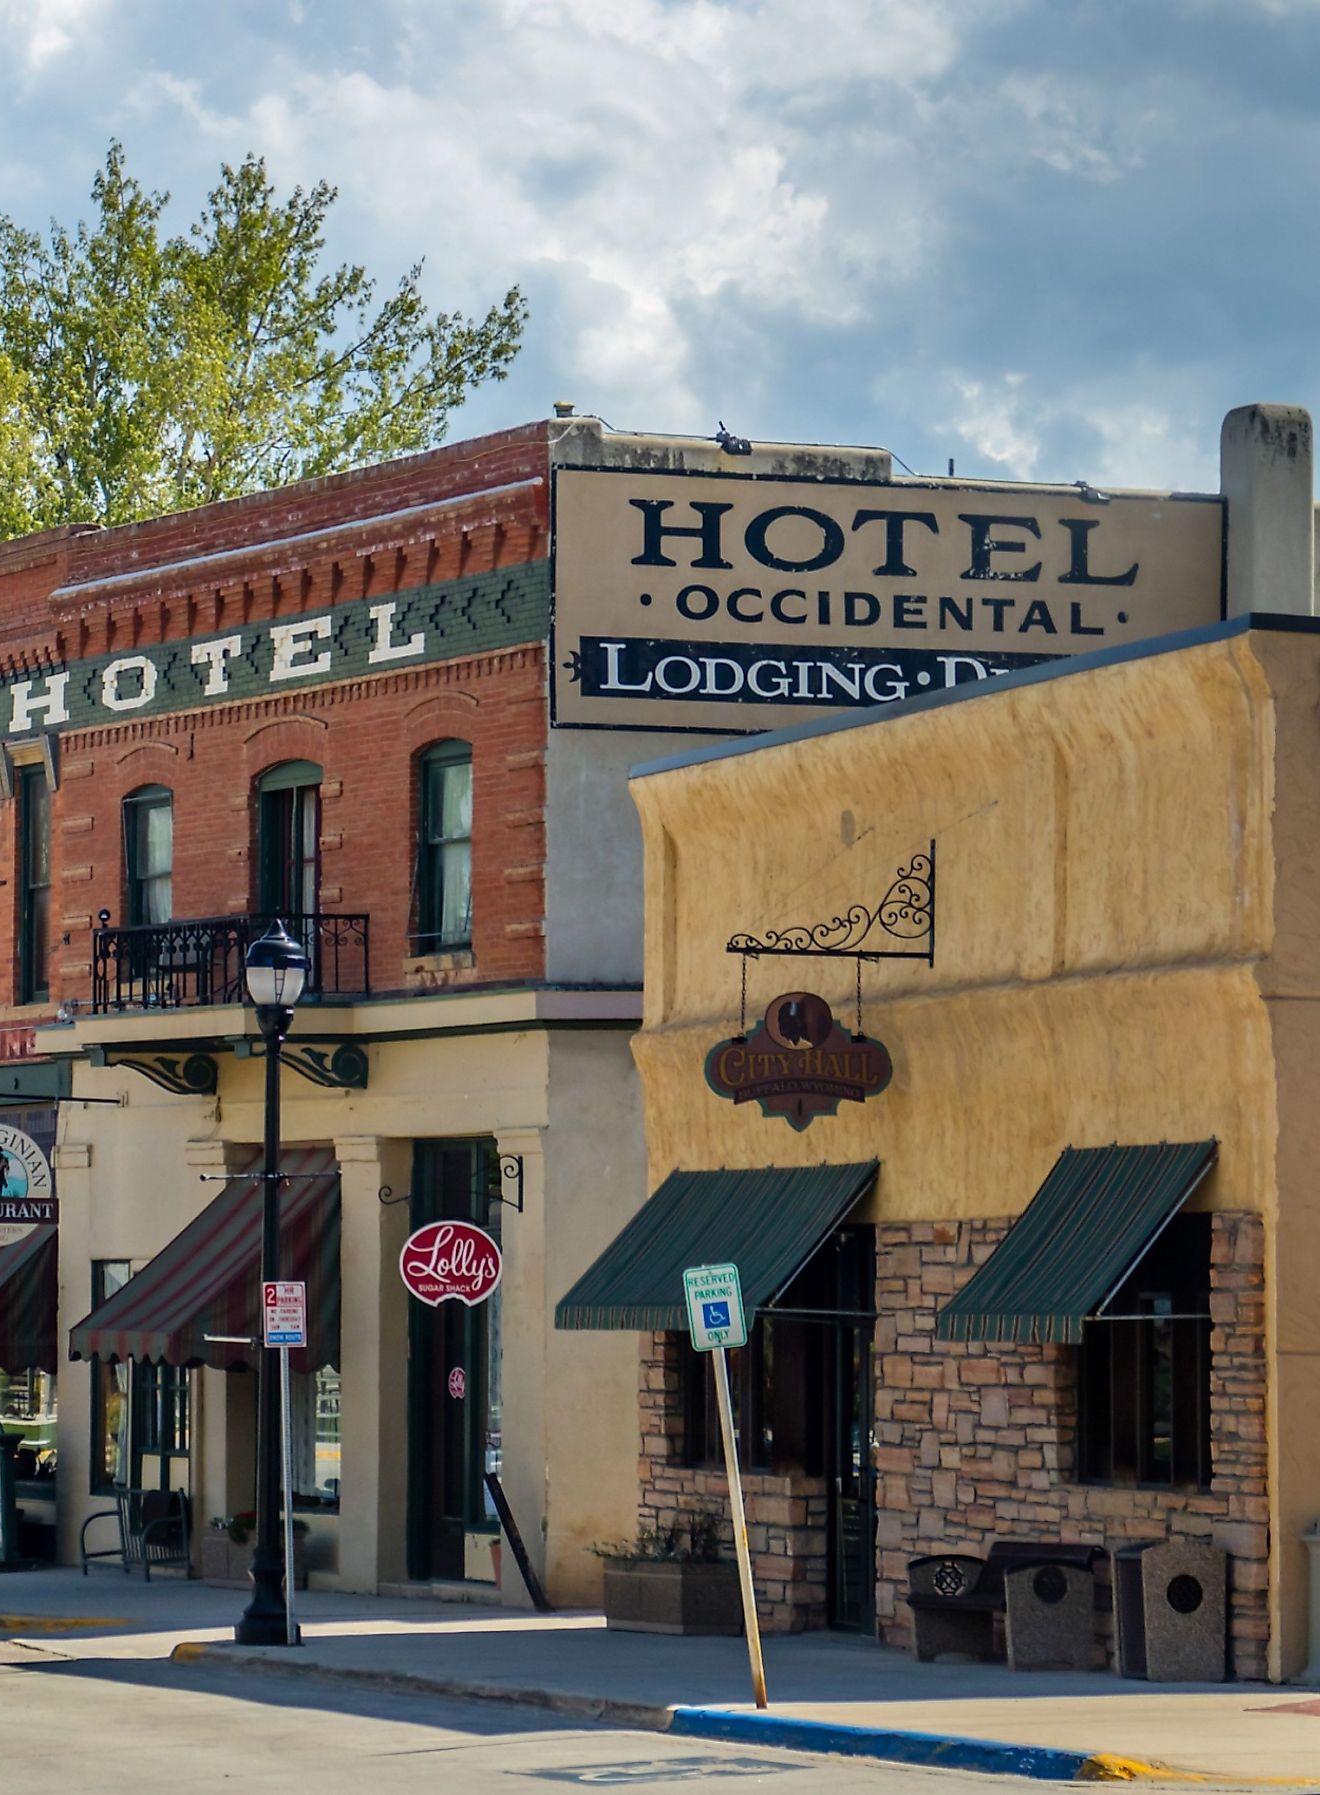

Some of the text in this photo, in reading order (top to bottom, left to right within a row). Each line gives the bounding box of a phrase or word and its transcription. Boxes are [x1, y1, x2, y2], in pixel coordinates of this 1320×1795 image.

[628, 498, 1139, 587] HOTEL
[676, 584, 1105, 636] OCCIDENTAL
[9, 602, 425, 732] HOTEL
[718, 1048, 878, 1086] CITY HALL
[408, 1226, 496, 1291] Lolly's
[418, 1284, 471, 1292] SUGAR SHACK
[687, 1273, 735, 1286] RESERVED
[266, 1288, 275, 1304] 2
[695, 1287, 732, 1300] PARKING
[708, 1329, 729, 1341] ONLY
